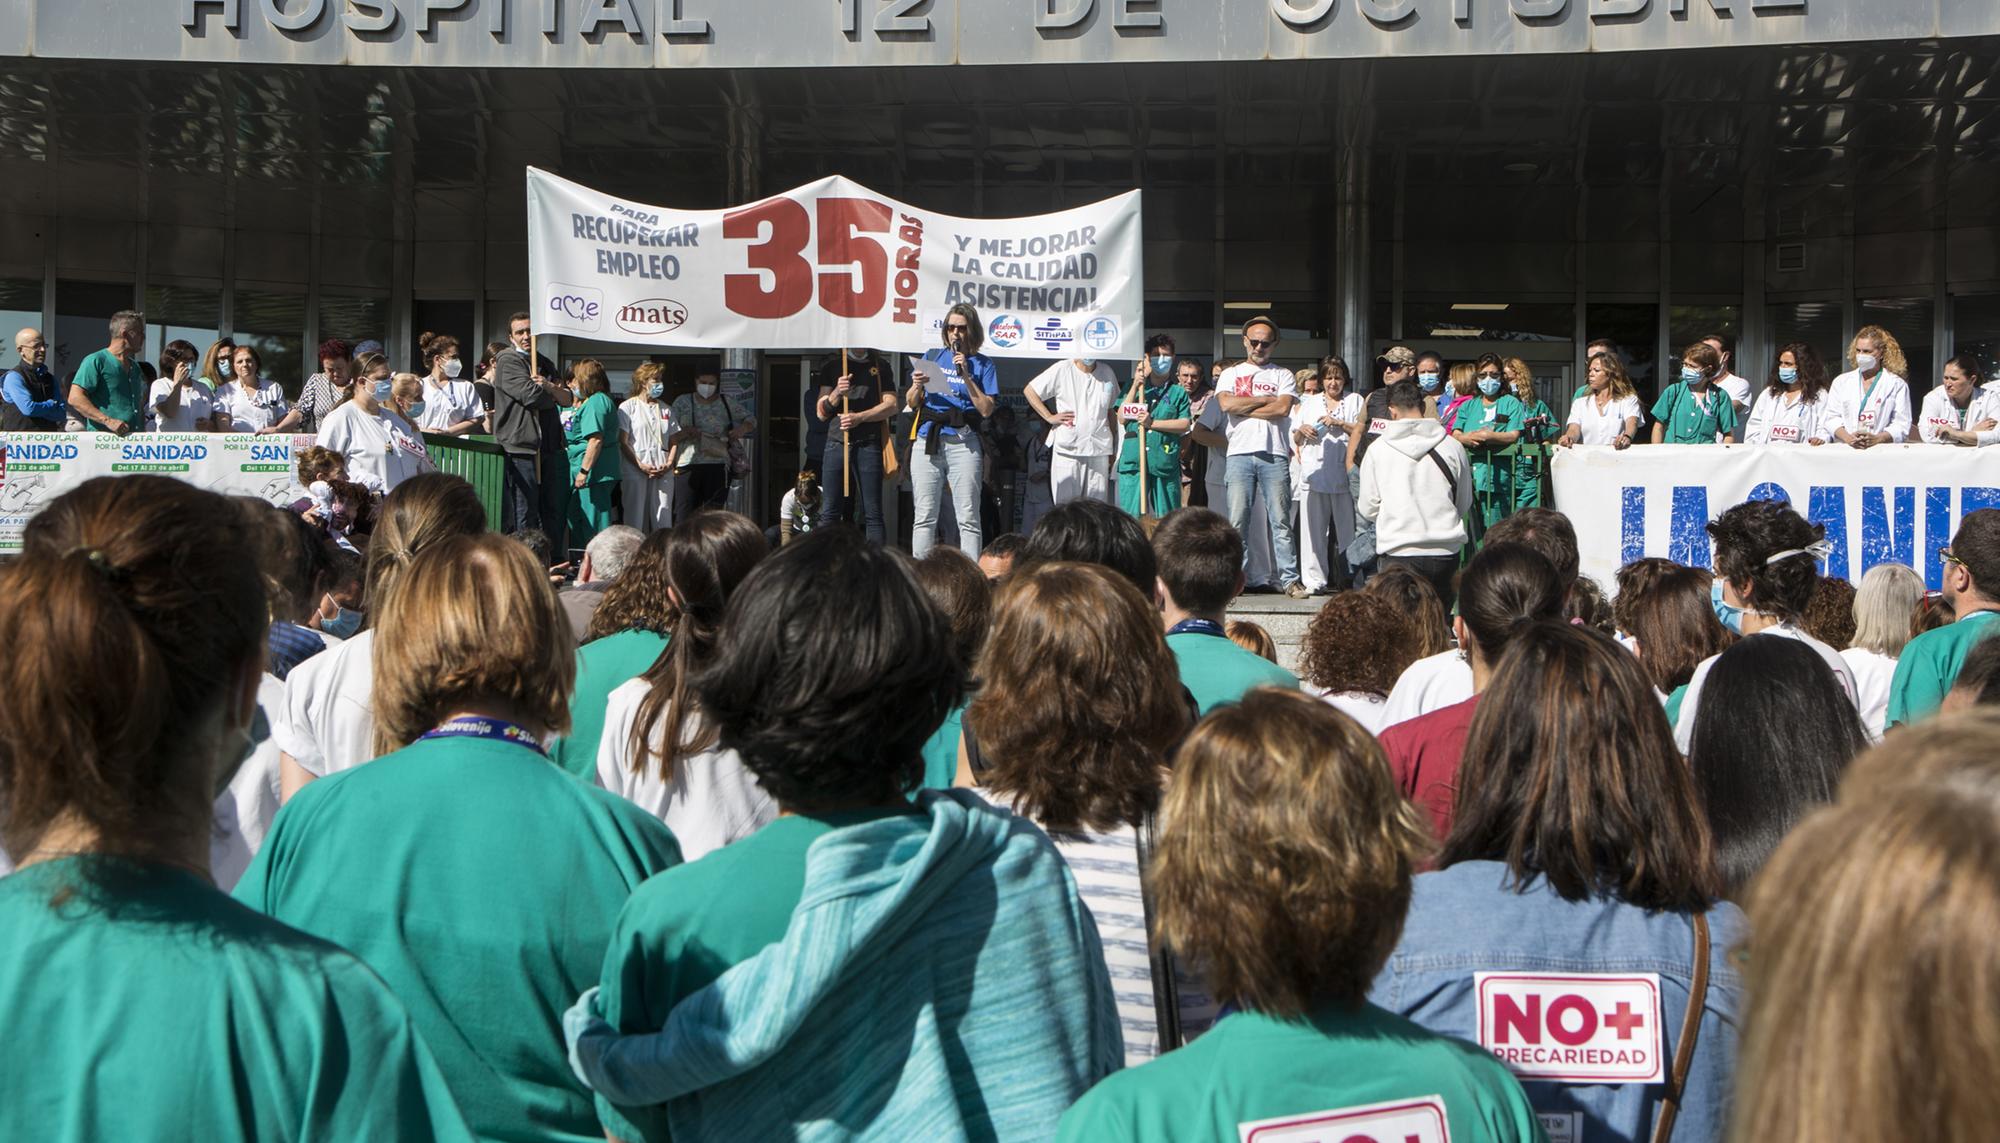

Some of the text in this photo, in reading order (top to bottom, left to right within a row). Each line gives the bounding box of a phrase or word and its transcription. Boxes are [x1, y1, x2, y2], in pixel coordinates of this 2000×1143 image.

[609, 203, 659, 226] PARA
[571, 213, 699, 248] RECUPERAR
[953, 224, 1098, 258] Y MEJORAR
[596, 248, 681, 281] EMPLEO
[722, 196, 893, 320] 35
[892, 212, 924, 325] HORAS
[951, 252, 1098, 281] LA CALIDAD
[944, 279, 1102, 313] ASISTENCIAL
[620, 303, 686, 326] mats
[994, 331, 1017, 339] SAR
[26, 434, 79, 442] POPULAR
[95, 434, 208, 442] CONSULTA POPULAR
[224, 435, 281, 443] CONSULTA
[1772, 427, 1797, 436] NO+
[6, 444, 79, 460] ANIDAD
[121, 444, 208, 460] SANIDAD
[1493, 993, 1644, 1046] NO+
[1493, 1047, 1647, 1065] PRECARIEDAD
